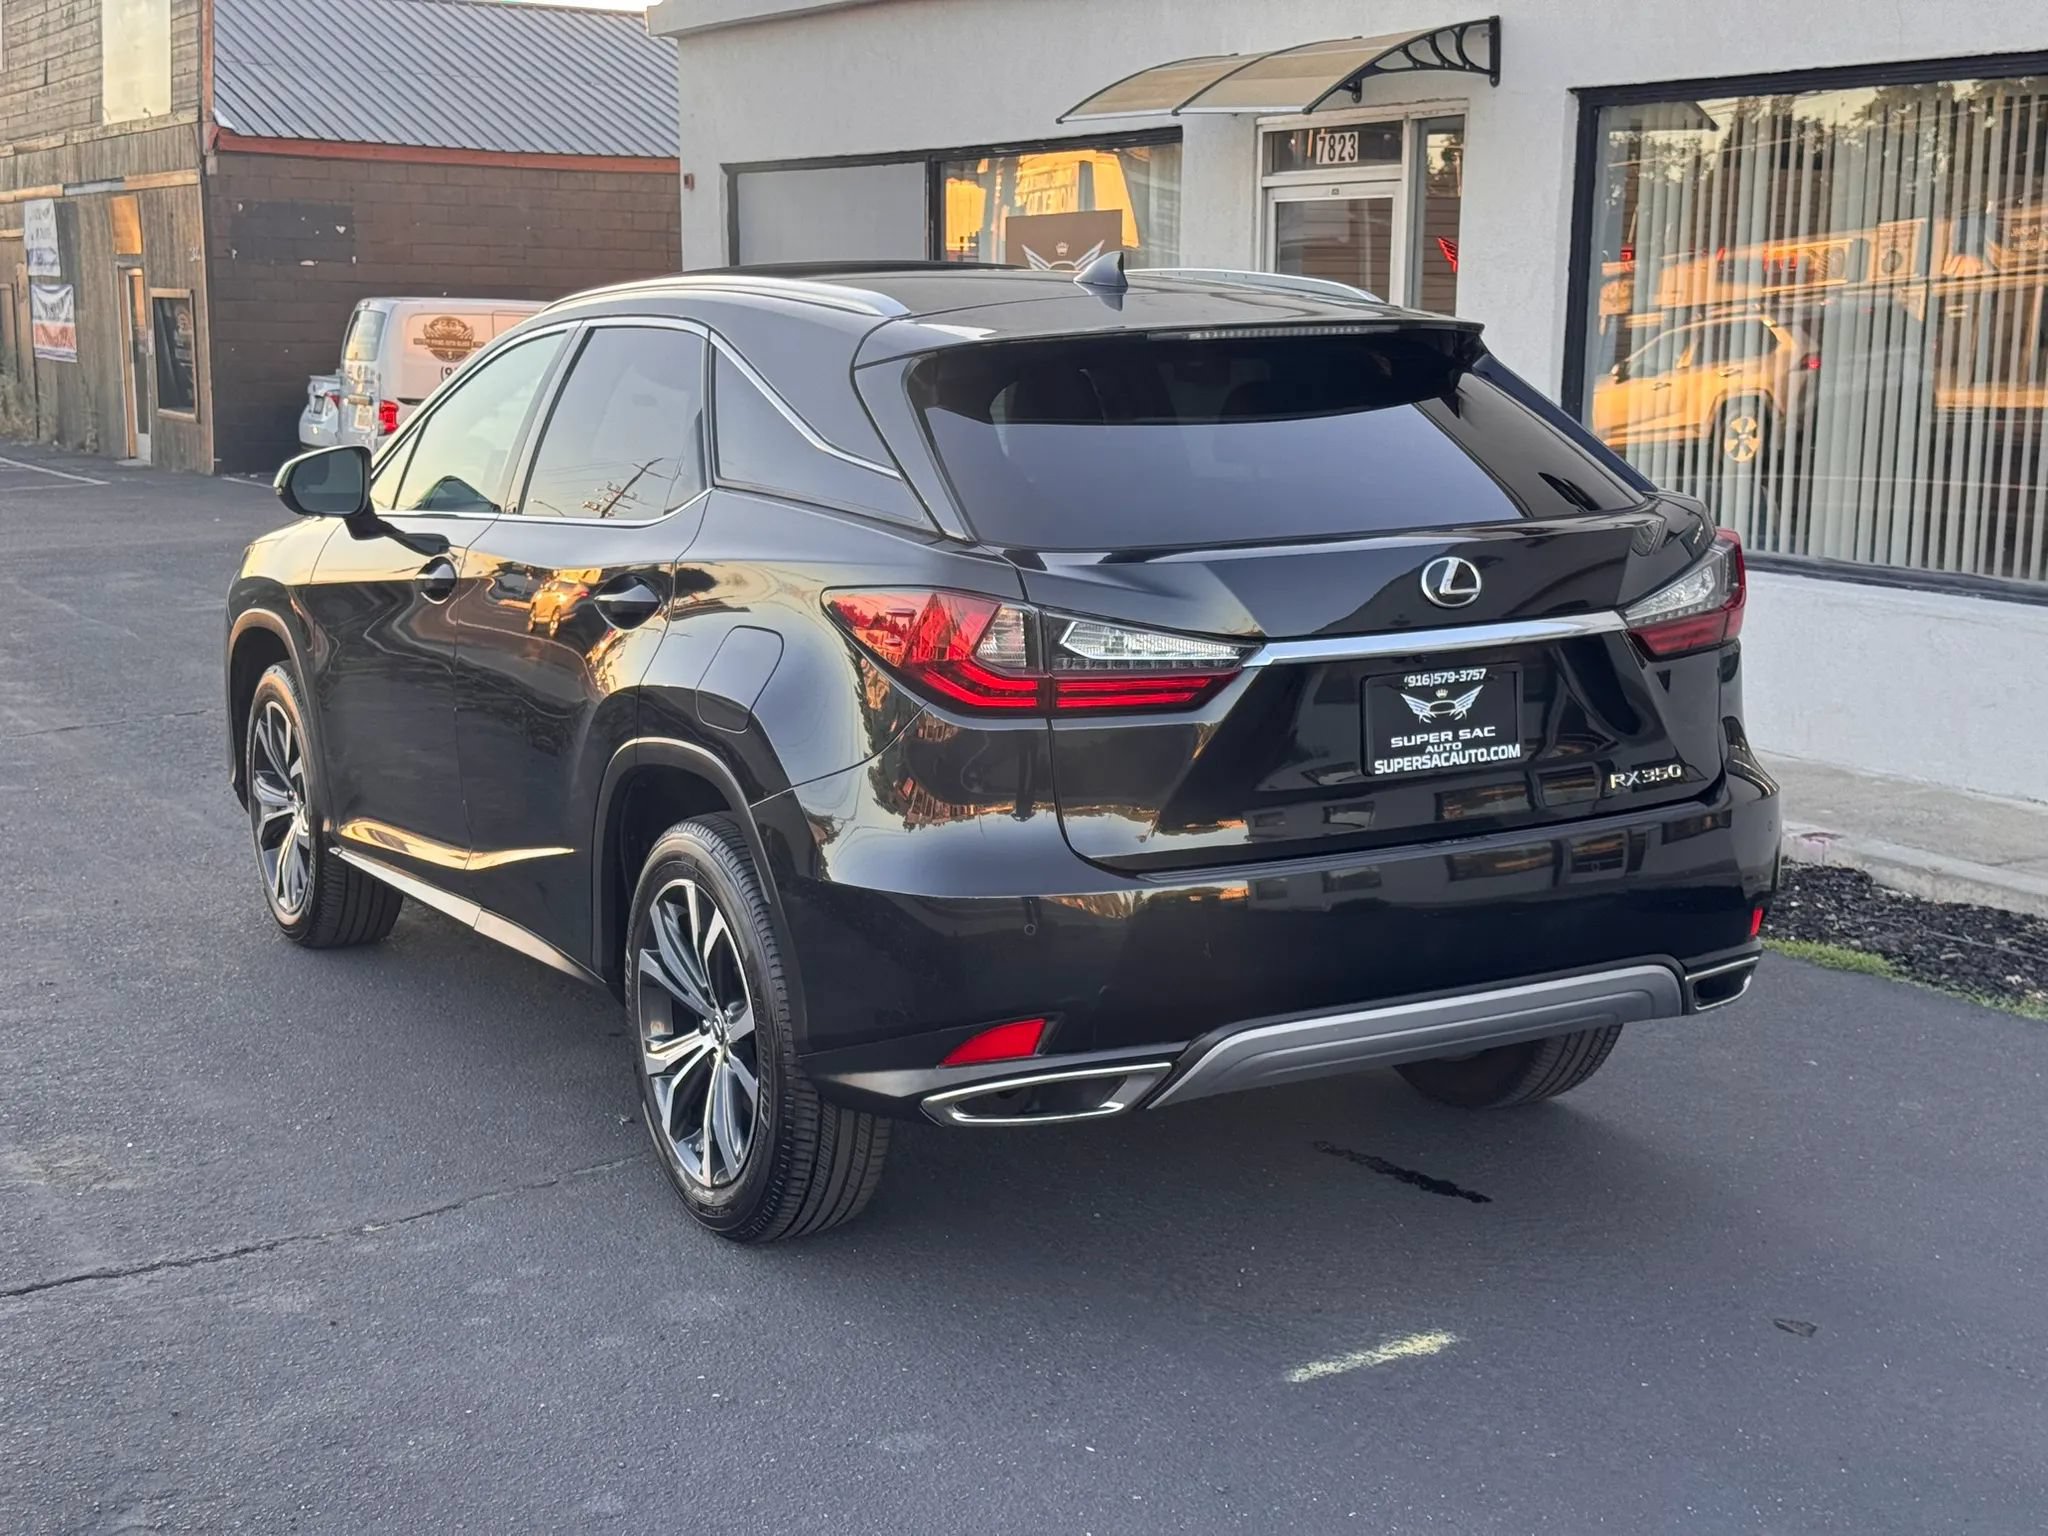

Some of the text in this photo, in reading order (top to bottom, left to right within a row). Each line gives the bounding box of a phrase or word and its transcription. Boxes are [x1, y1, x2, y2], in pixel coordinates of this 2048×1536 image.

[1319, 134, 1356, 163] 7823
[1404, 668, 1487, 688] (916)579-3757
[1391, 726, 1496, 748] SUPER SAC
[1425, 742, 1462, 753] AUTO
[1374, 744, 1521, 774] SUPERSACAUTO.COM
